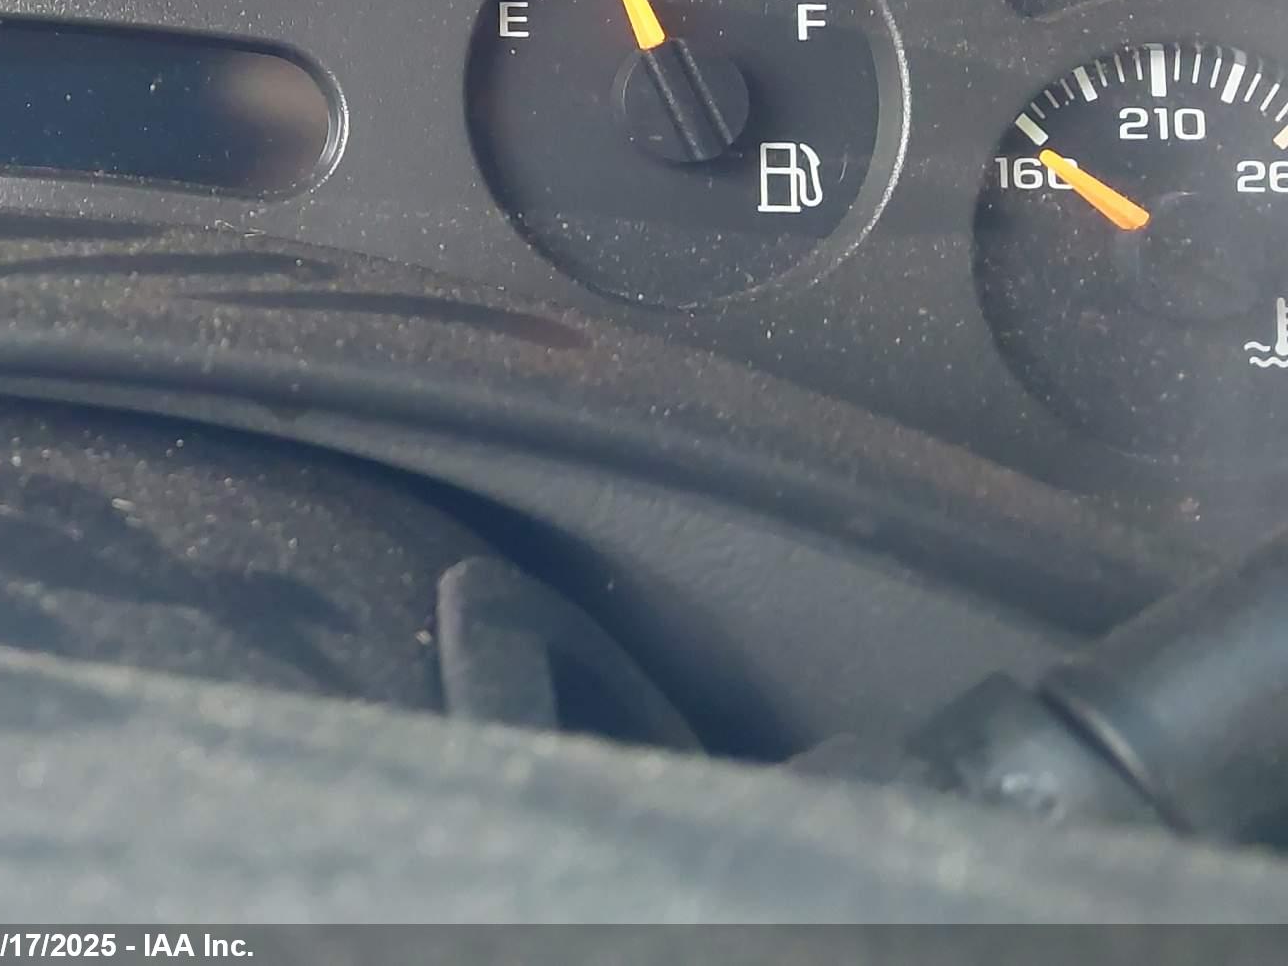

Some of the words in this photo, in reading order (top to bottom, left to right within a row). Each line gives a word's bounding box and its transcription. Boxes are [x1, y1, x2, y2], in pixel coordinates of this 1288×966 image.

[499, 1, 530, 38] E
[797, 3, 827, 41] F
[1118, 107, 1206, 141] 210
